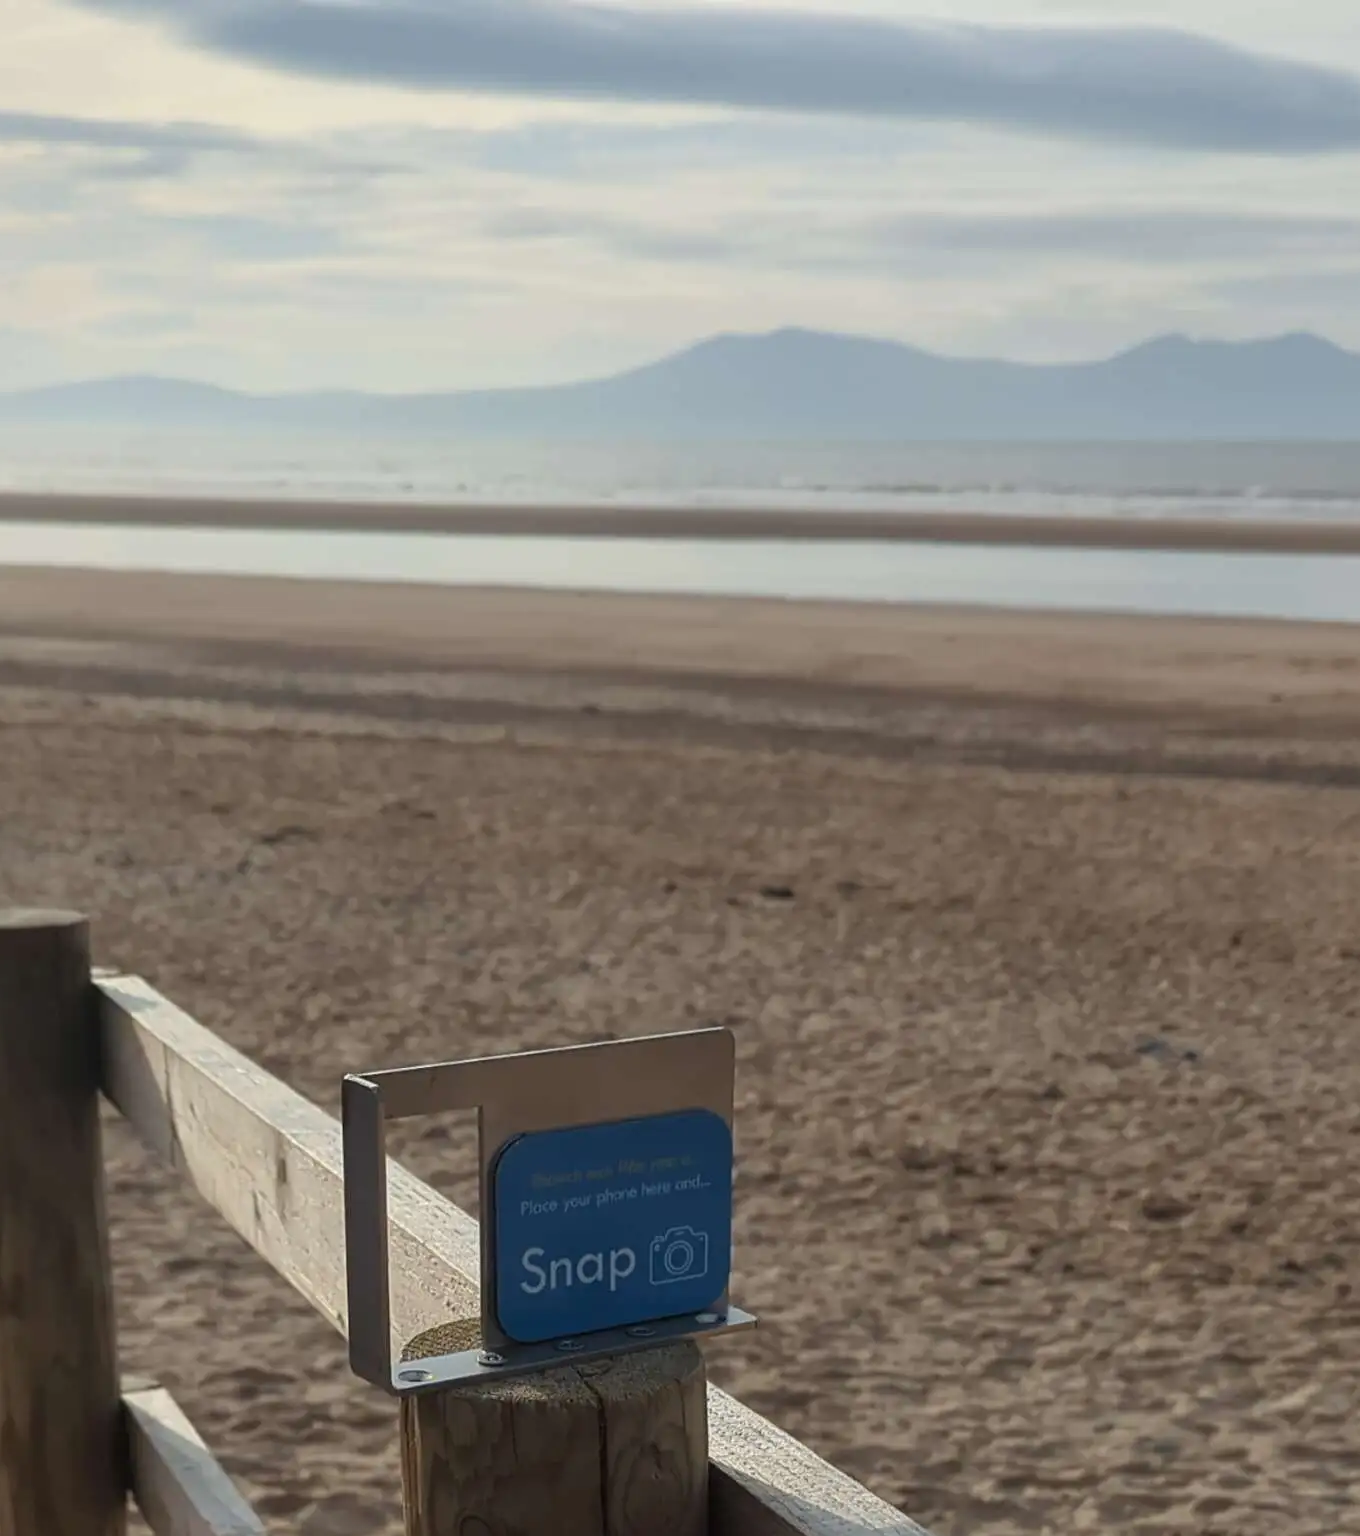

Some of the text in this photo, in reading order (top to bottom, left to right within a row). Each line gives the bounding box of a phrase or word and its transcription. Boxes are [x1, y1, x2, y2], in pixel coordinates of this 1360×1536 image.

[520, 1200, 559, 1217] Place
[562, 1195, 593, 1214] your
[596, 1186, 638, 1209] phone
[640, 1182, 671, 1199] here
[519, 1245, 636, 1296] Snap
